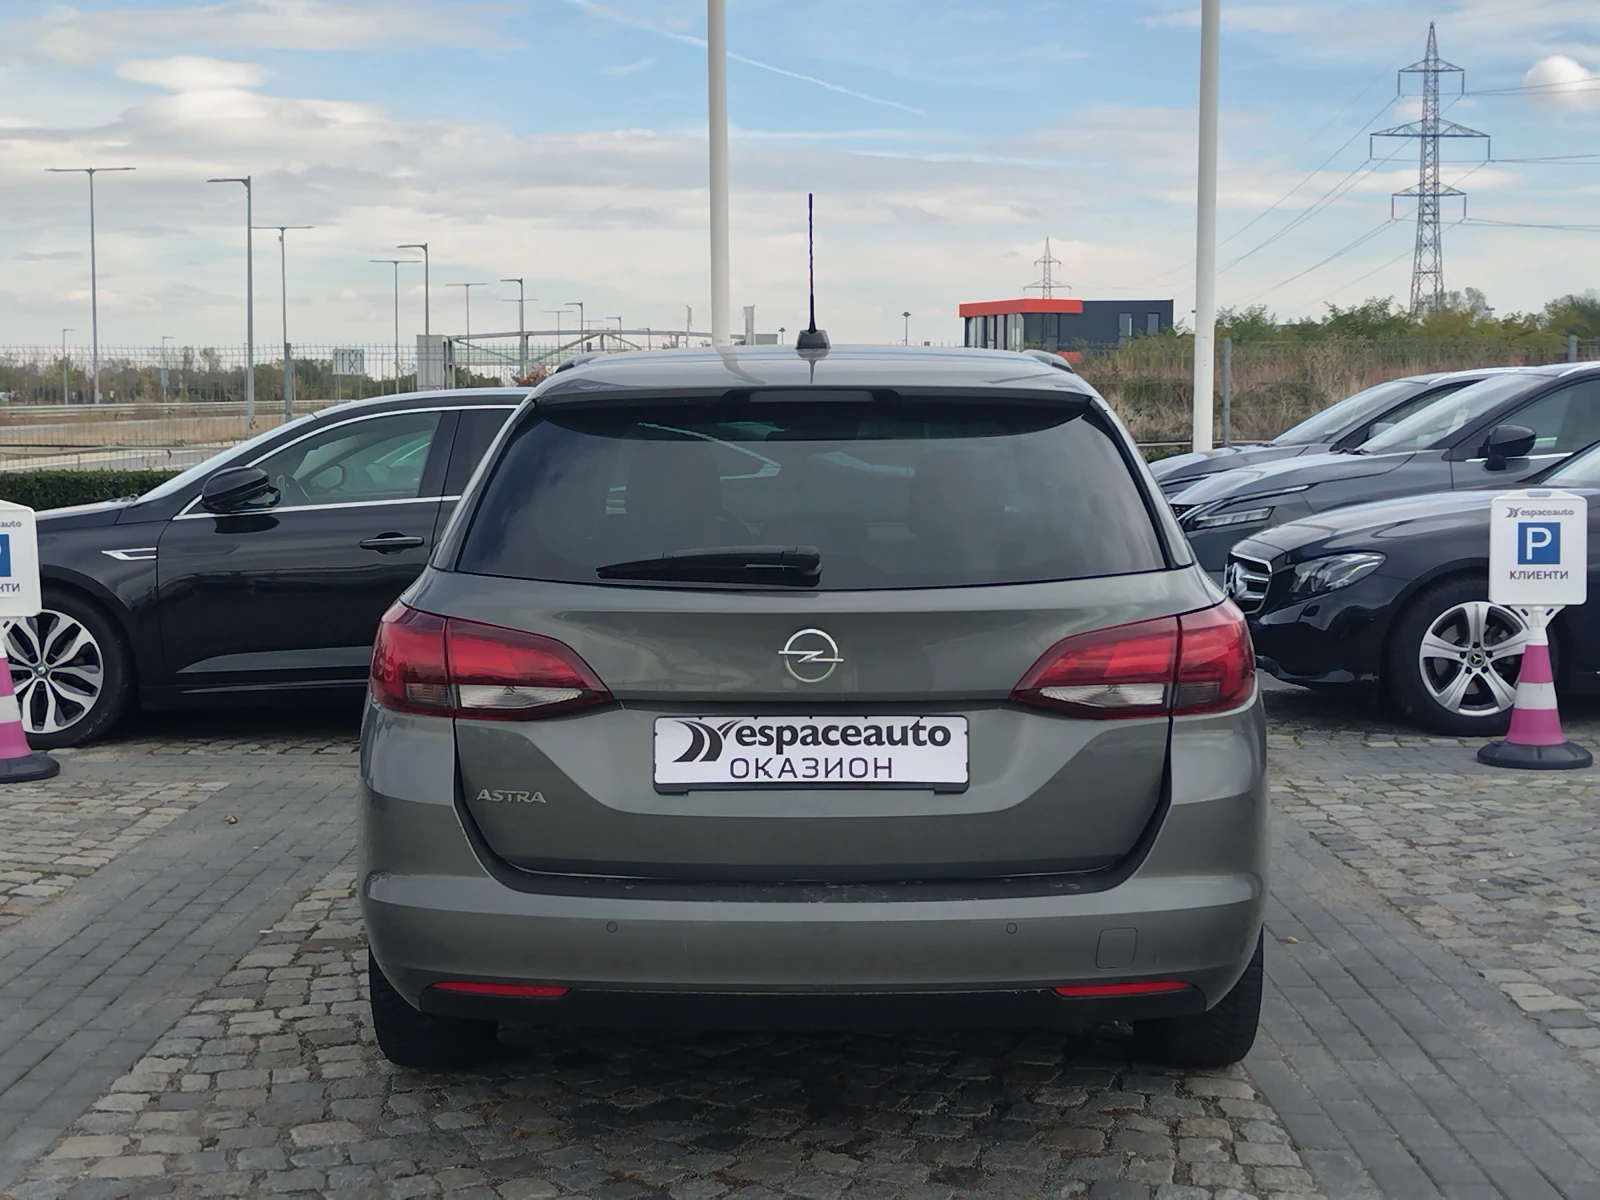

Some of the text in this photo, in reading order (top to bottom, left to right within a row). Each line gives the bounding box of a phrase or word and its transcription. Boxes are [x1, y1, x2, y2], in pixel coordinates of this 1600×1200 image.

[1520, 509, 1575, 518] espaceauto
[1526, 527, 1552, 560] P
[1509, 570, 1569, 580] КЛИЕНТИ
[735, 719, 951, 755] espaceauto
[729, 757, 893, 779] ОКАЗИОН
[476, 788, 547, 804] ASTRA
